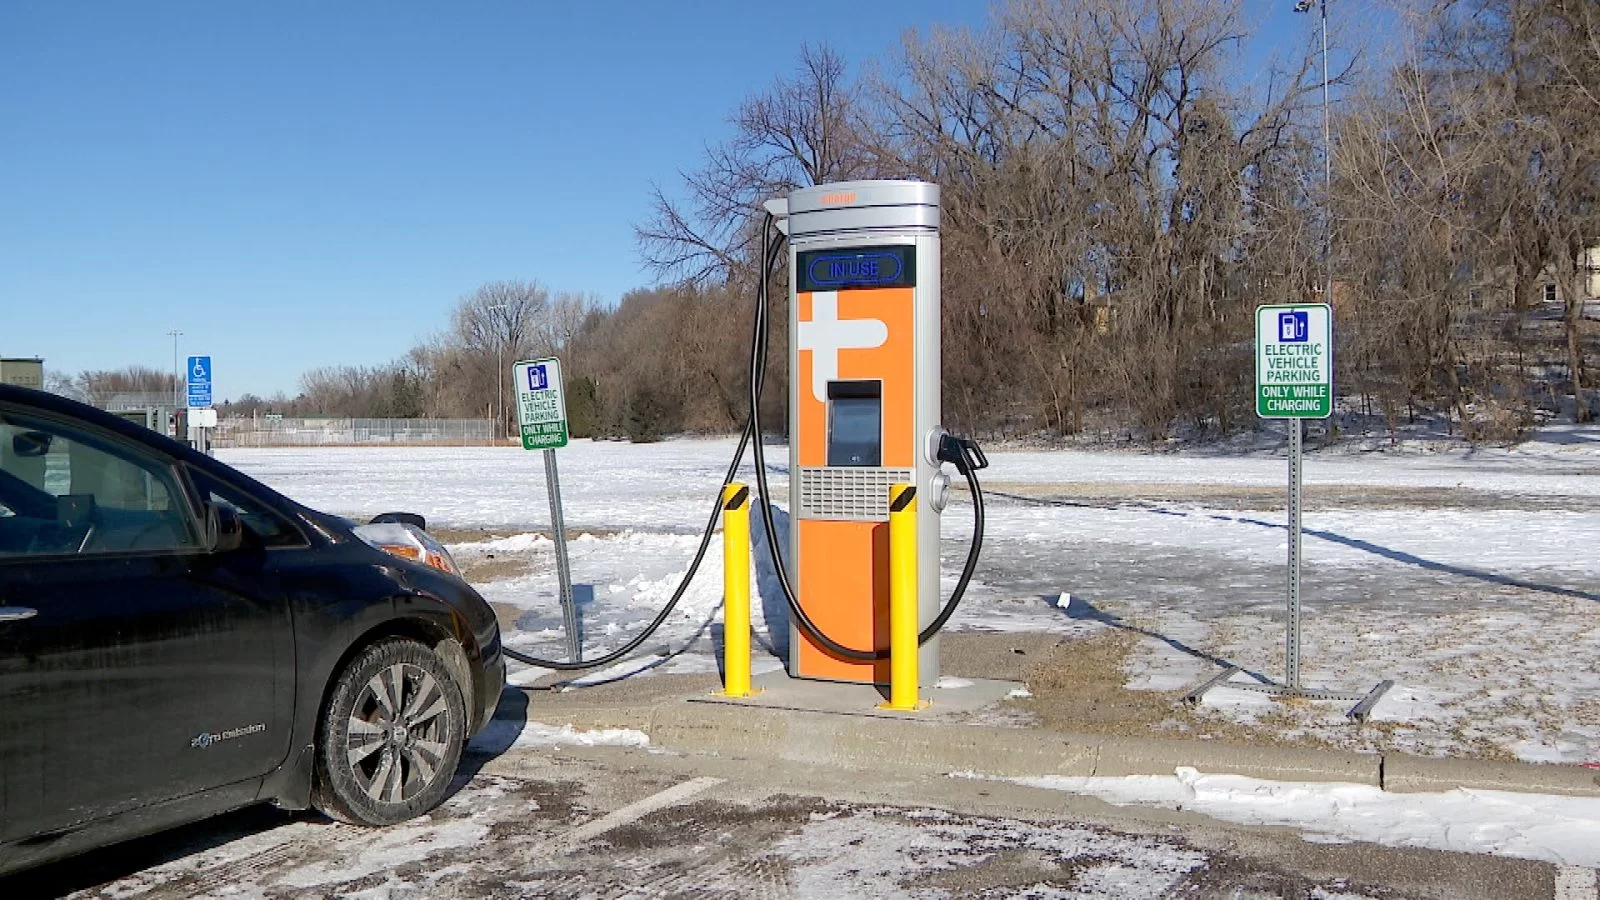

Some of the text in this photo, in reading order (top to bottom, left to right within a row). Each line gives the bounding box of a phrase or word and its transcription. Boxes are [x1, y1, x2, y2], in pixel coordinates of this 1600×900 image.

[830, 260, 879, 278] IN USE
[1265, 343, 1322, 355] ELECTRIC
[1268, 357, 1318, 369] VEHICLE
[1267, 370, 1320, 382] PARKING
[521, 389, 558, 402] ELECTRIC
[1262, 386, 1326, 398] ONLY WHILE
[525, 400, 556, 412] VEHICLE
[1267, 399, 1320, 411] CHARGING
[525, 410, 559, 422] PARKING
[523, 422, 564, 435] ONLY WHILE
[528, 433, 562, 446] CHARGING
